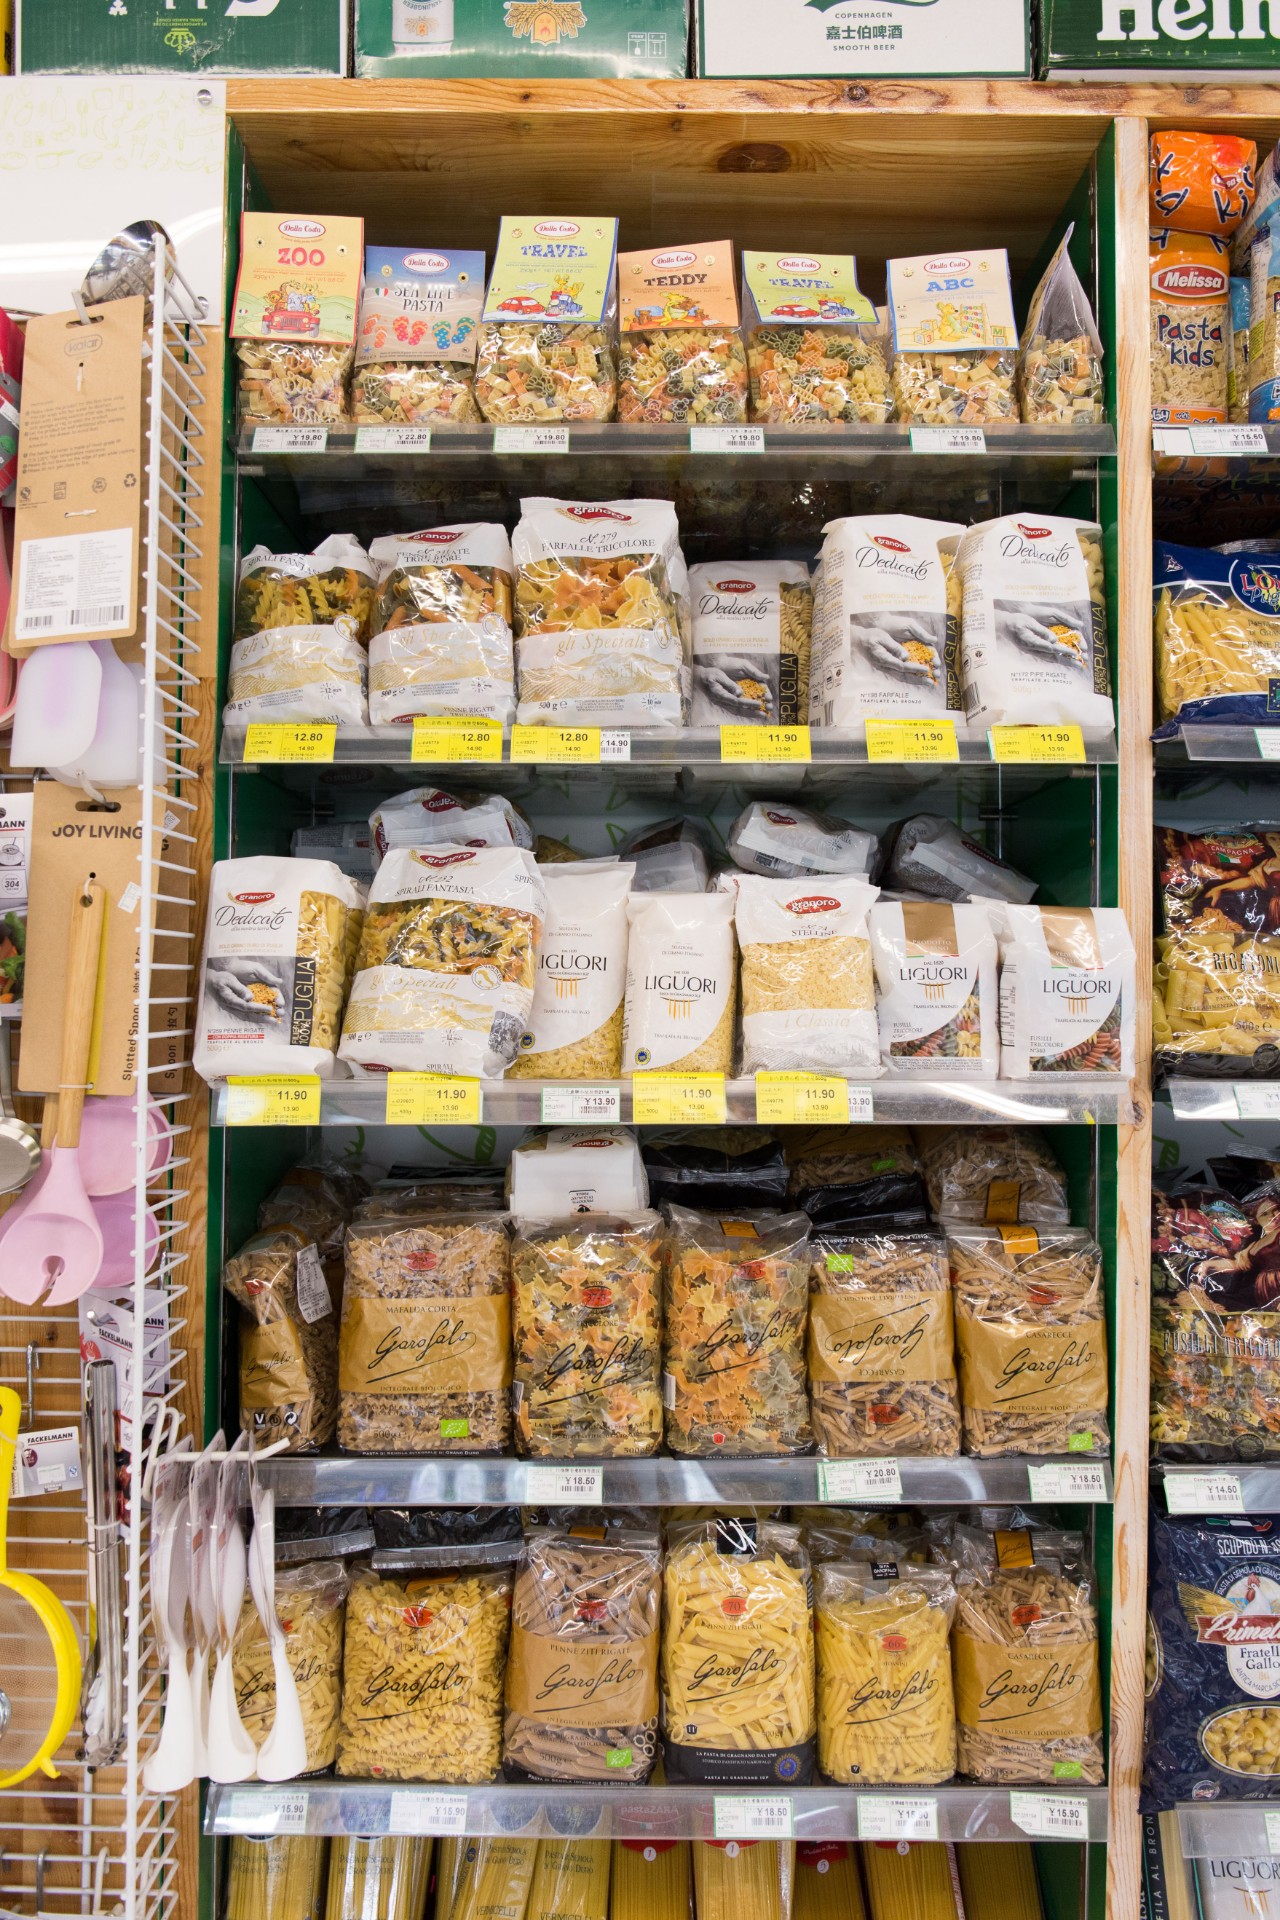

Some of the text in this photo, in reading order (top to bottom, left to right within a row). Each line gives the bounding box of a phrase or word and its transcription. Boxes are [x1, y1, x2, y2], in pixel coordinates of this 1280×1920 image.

[834, 11, 893, 19] COPENHAGEN
[825, 24, 903, 40] 嘉士伯啤酒
[833, 44, 896, 52] SMOOTH BEER
[277, 247, 326, 267] ZOO
[520, 244, 589, 258] TRAVEL
[644, 273, 708, 287] TEDDY
[768, 278, 835, 290] TRAVEL
[926, 278, 976, 292] ABC
[1164, 271, 1223, 289] Melissa
[402, 300, 444, 313] PASTA
[1158, 314, 1222, 343] Pasta
[1170, 342, 1215, 368] kids
[739, 434, 760, 442] 19.80
[960, 434, 982, 442] 19.80
[600, 532, 618, 543] 279
[541, 538, 656, 554] FARFALLE TRICOLORE
[1000, 534, 1076, 568] Dedicato
[855, 546, 932, 580] Dedicato
[720, 582, 755, 590] granoro
[700, 595, 775, 620] Dedicato
[1093, 606, 1106, 668] PUGLIA
[780, 655, 798, 715] PUGLIA
[294, 733, 323, 742] 12.80
[462, 734, 490, 742] 12.80
[560, 733, 588, 742] 12.80
[768, 734, 798, 742] 11.90
[914, 733, 943, 741] 11.90
[1040, 734, 1070, 742] 11.90
[52, 824, 143, 840] JOY LIVING
[1210, 845, 1254, 855] CAMPAGNA
[4, 880, 20, 888] 304
[426, 884, 475, 896] FANTASIA
[238, 894, 272, 902] granoro
[214, 906, 292, 930] Dedicato
[900, 968, 968, 981] LIGUORI
[645, 975, 717, 994] LIGUORI
[1043, 979, 1112, 994] LIGUORI
[301, 959, 316, 1024] PUGLIA
[123, 1038, 137, 1081] Slotted
[278, 1090, 308, 1100] 11.90
[436, 1090, 466, 1099] 11.90
[682, 1088, 712, 1098] 11.90
[806, 1089, 835, 1099] 11.90
[592, 1097, 616, 1106] 13.90
[848, 1098, 870, 1106] 13.90
[386, 1304, 456, 1314] MAFALDA CORTA
[99, 1327, 133, 1350] FACKELMANN
[826, 1313, 931, 1364] Garofalo
[1025, 1331, 1073, 1340] CASARECCE
[368, 1319, 476, 1370] Garofalo
[1164, 1332, 1218, 1354] FUSILLI
[540, 1336, 653, 1390] Garofalo
[996, 1341, 1098, 1390] Garofalo
[420, 1384, 462, 1392] BIOLOGICO
[27, 1432, 74, 1444] FACKELMANN
[874, 1468, 896, 1477] 20.80
[1079, 1474, 1101, 1482] 18.50
[574, 1476, 595, 1484] 18.50
[1216, 1485, 1238, 1494] 14.50
[1233, 1566, 1256, 1579] SEMOLA
[728, 1600, 741, 1612] 70
[550, 1644, 576, 1652] PENNE
[1008, 1652, 1054, 1660] CASARECCE
[688, 1648, 788, 1695] Garofalo
[361, 1662, 474, 1706] Garofalo
[536, 1660, 646, 1700] Garofalo
[848, 1668, 940, 1714] Garofalo
[978, 1669, 1084, 1710] Garofalo
[282, 1804, 304, 1812] 15.90
[443, 1807, 466, 1816] 15.90
[764, 1808, 788, 1816] 18.50
[1056, 1808, 1080, 1818] 15.90
[1152, 1864, 1160, 1880] AL
